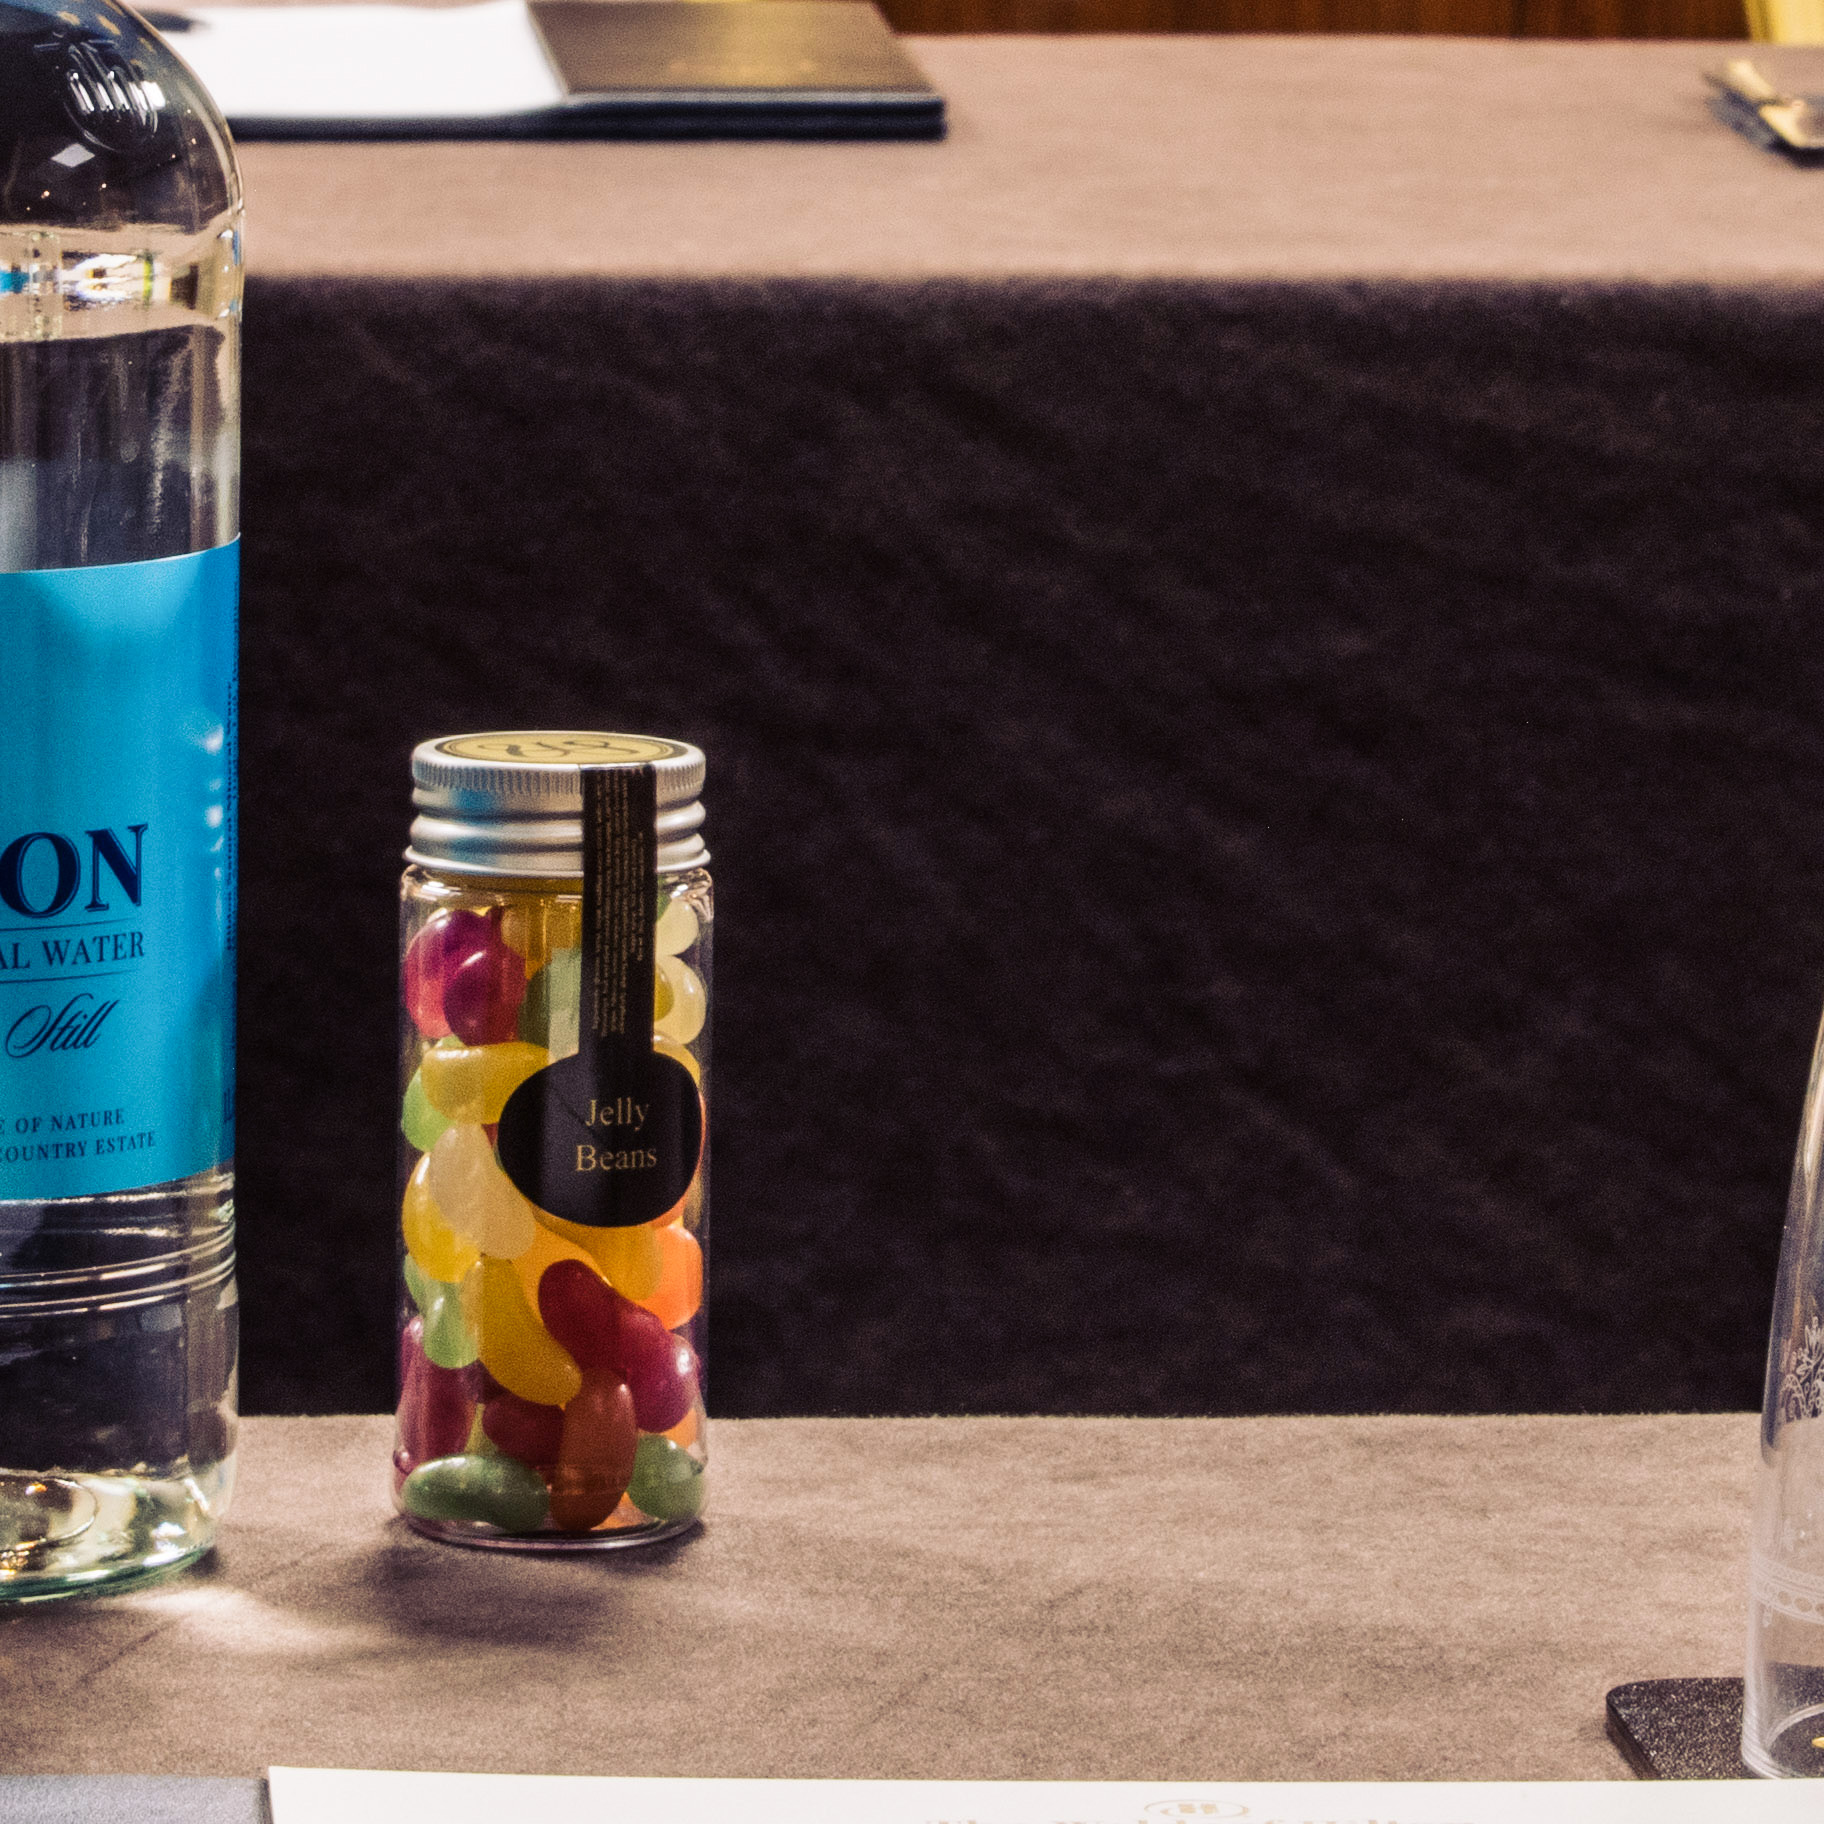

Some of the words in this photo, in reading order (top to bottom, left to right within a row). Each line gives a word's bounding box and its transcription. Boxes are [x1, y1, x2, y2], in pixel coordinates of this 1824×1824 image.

[41, 931, 145, 967] WATER
[5, 993, 120, 1058] Still
[15, 1117, 42, 1134] OF
[51, 1108, 125, 1129] NATURE
[585, 1096, 649, 1132] Jelly
[95, 1131, 156, 1155] ESTATE
[576, 1144, 657, 1171] Beans
